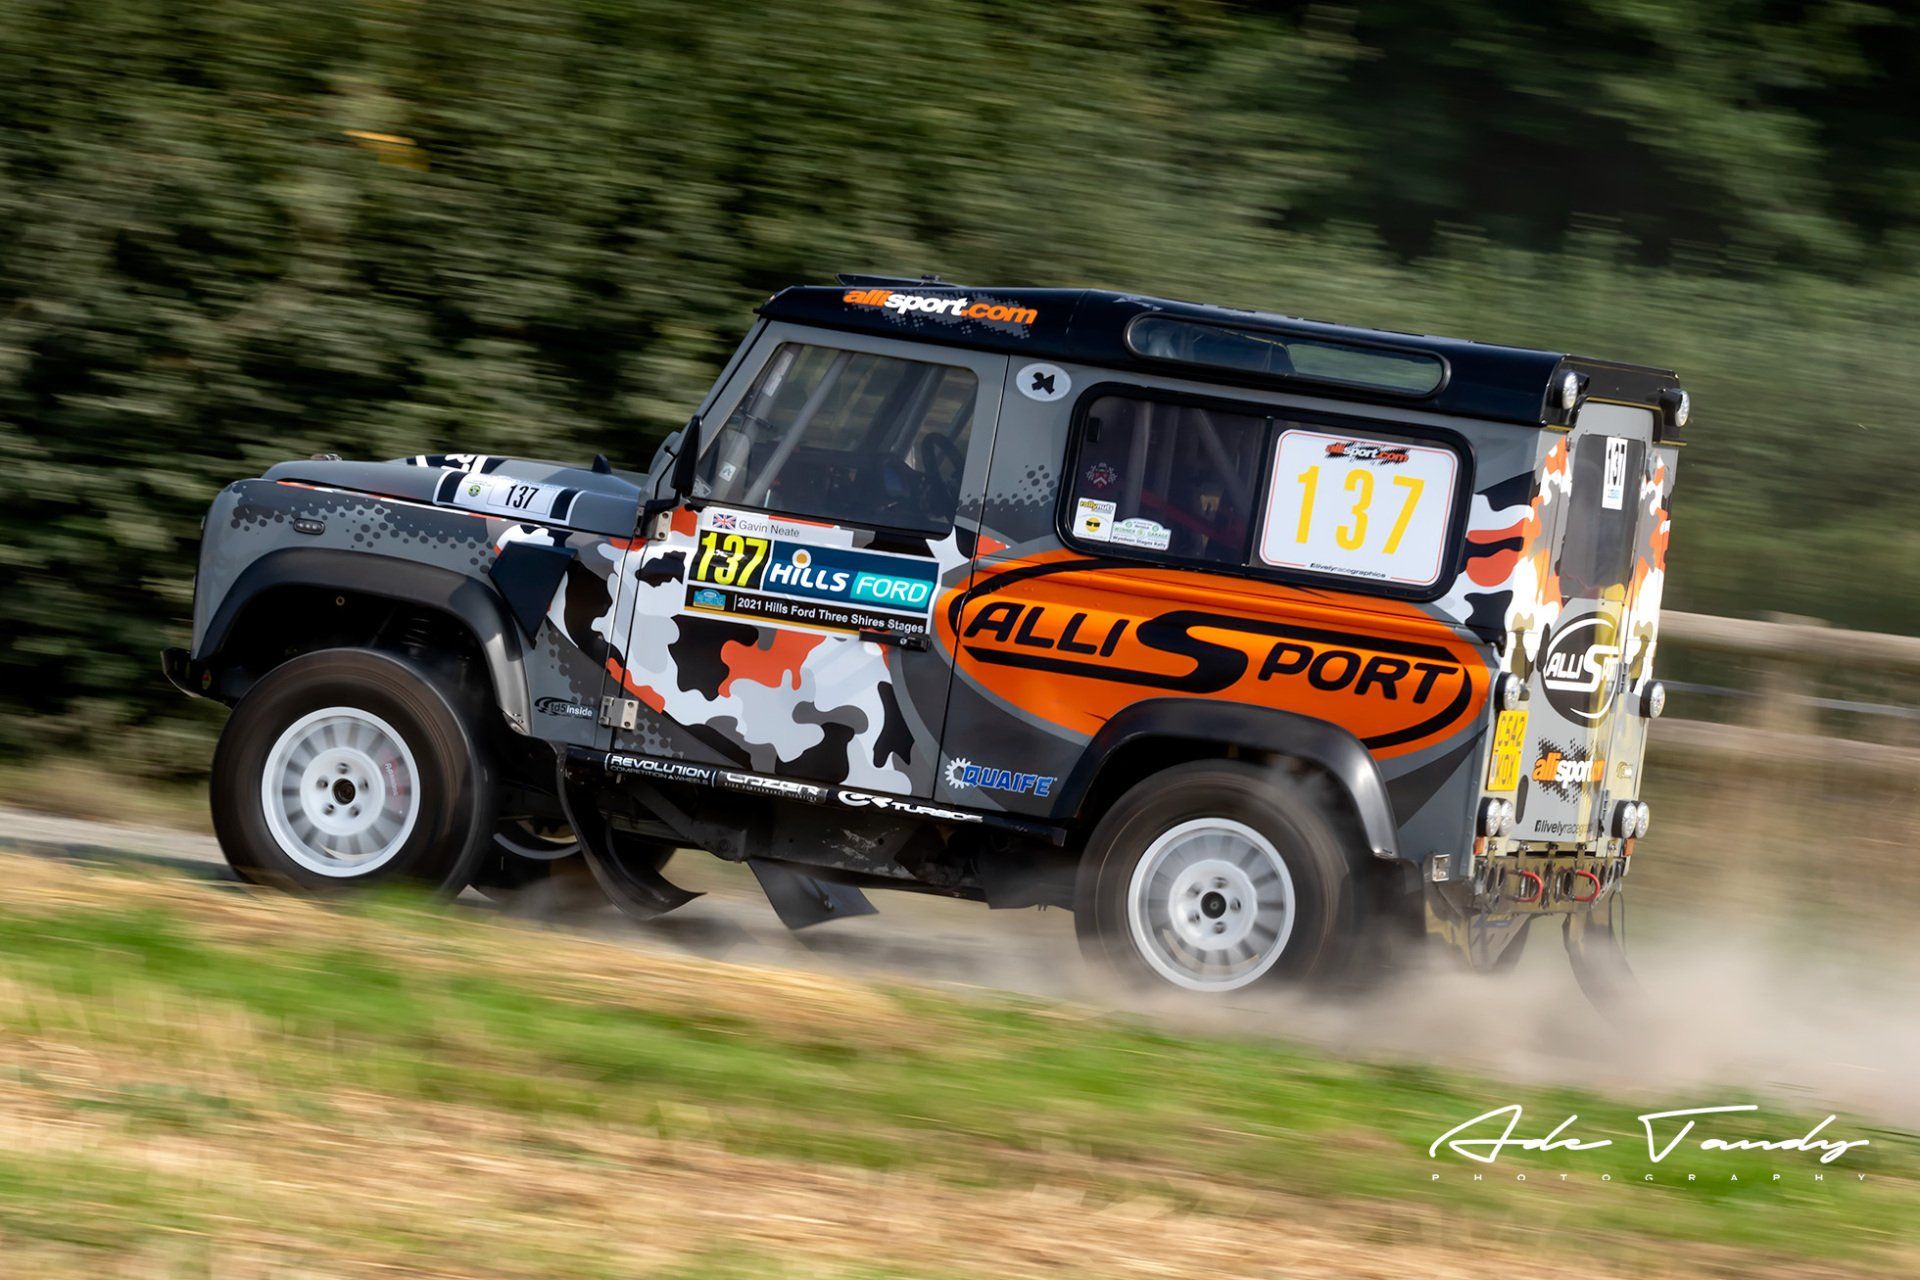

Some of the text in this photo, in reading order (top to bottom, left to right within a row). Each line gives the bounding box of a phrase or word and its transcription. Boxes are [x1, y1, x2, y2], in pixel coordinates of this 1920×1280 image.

[843, 289, 1038, 325] allisport.com
[505, 484, 540, 509] 137
[1295, 465, 1425, 556] 137
[738, 519, 800, 538] Gavin Neate
[697, 532, 769, 588] 137
[856, 576, 928, 603] FORD
[737, 597, 762, 611] 2021
[765, 602, 788, 614] Hills
[790, 605, 816, 618] Ford
[818, 609, 848, 623] Three
[851, 613, 885, 628] Shires
[887, 618, 924, 635] Stages
[611, 755, 711, 779] REVOLUTION
[961, 764, 1055, 797] QUAIFE
